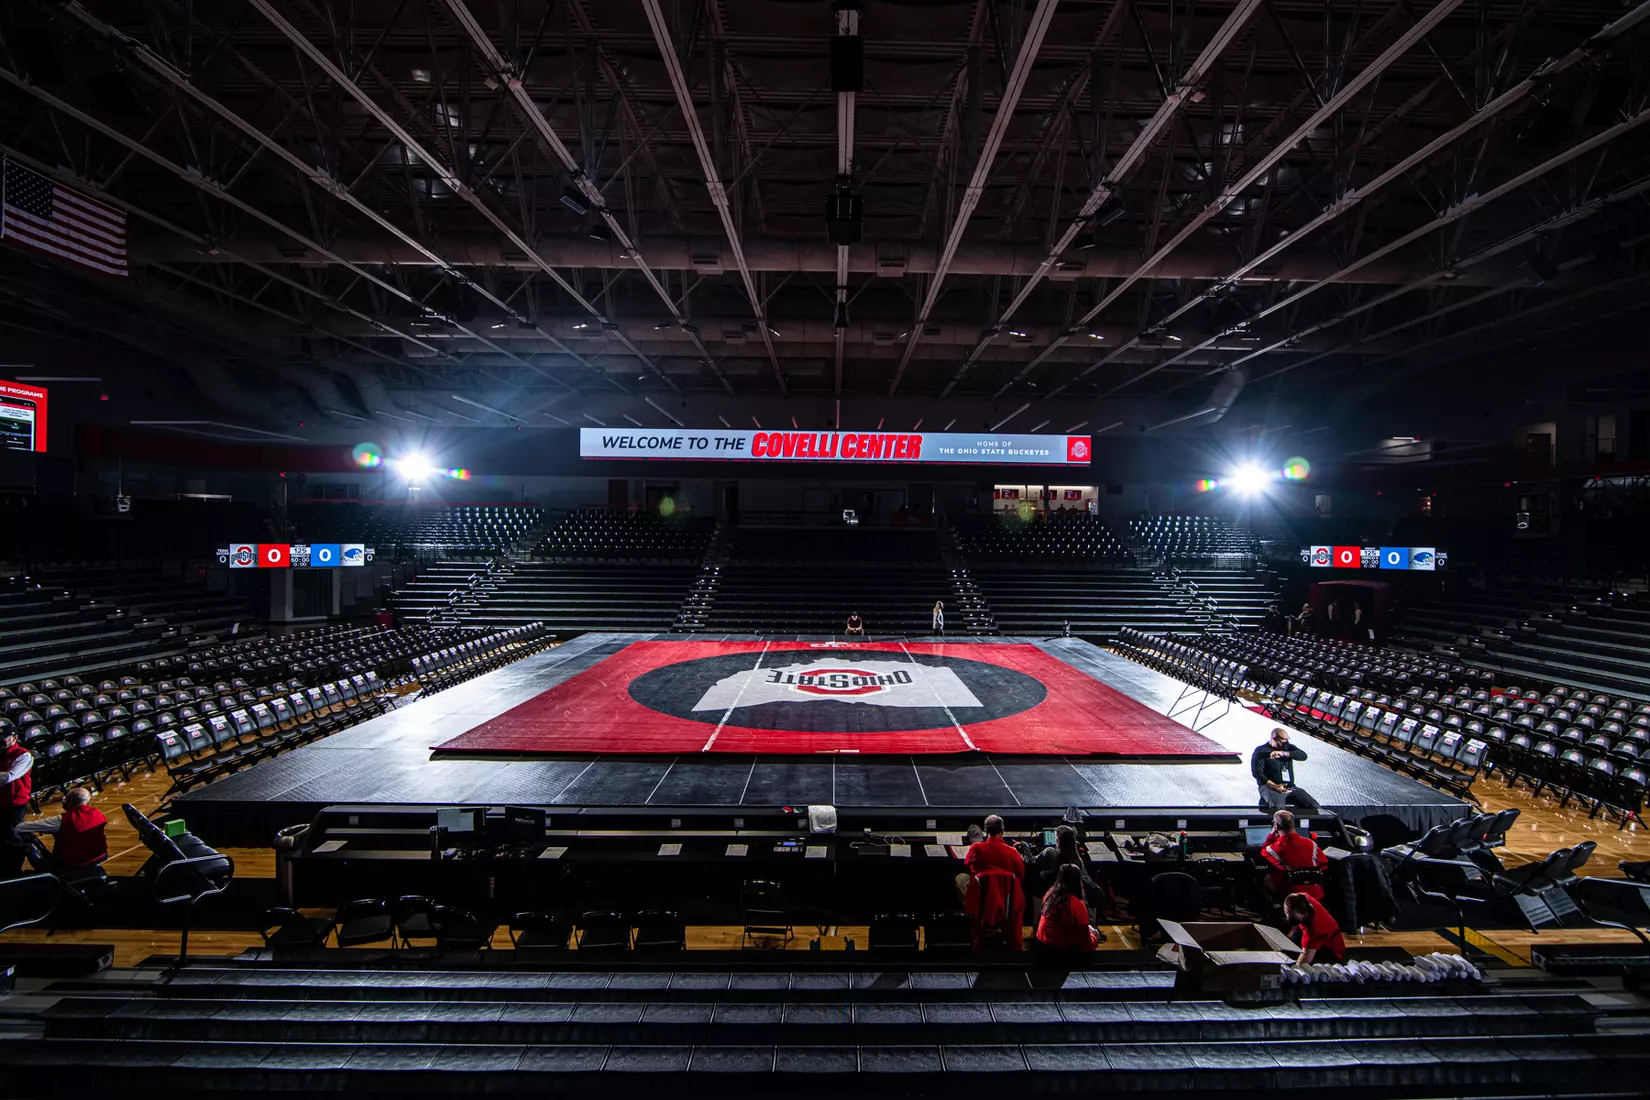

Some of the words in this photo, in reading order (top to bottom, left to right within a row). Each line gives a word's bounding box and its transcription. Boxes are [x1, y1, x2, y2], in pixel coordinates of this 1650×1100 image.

[7, 387, 43, 398] PROGRAMS
[602, 435, 682, 449] WELCOME
[687, 437, 709, 450] TO
[714, 437, 746, 450] THE
[751, 432, 839, 458] COVELLI
[840, 433, 923, 459] CENTER
[1008, 448, 1049, 456] BUCKEYES
[267, 548, 281, 562] 0
[319, 548, 331, 562] 0
[1341, 550, 1353, 563] 0
[1388, 551, 1400, 565] 0
